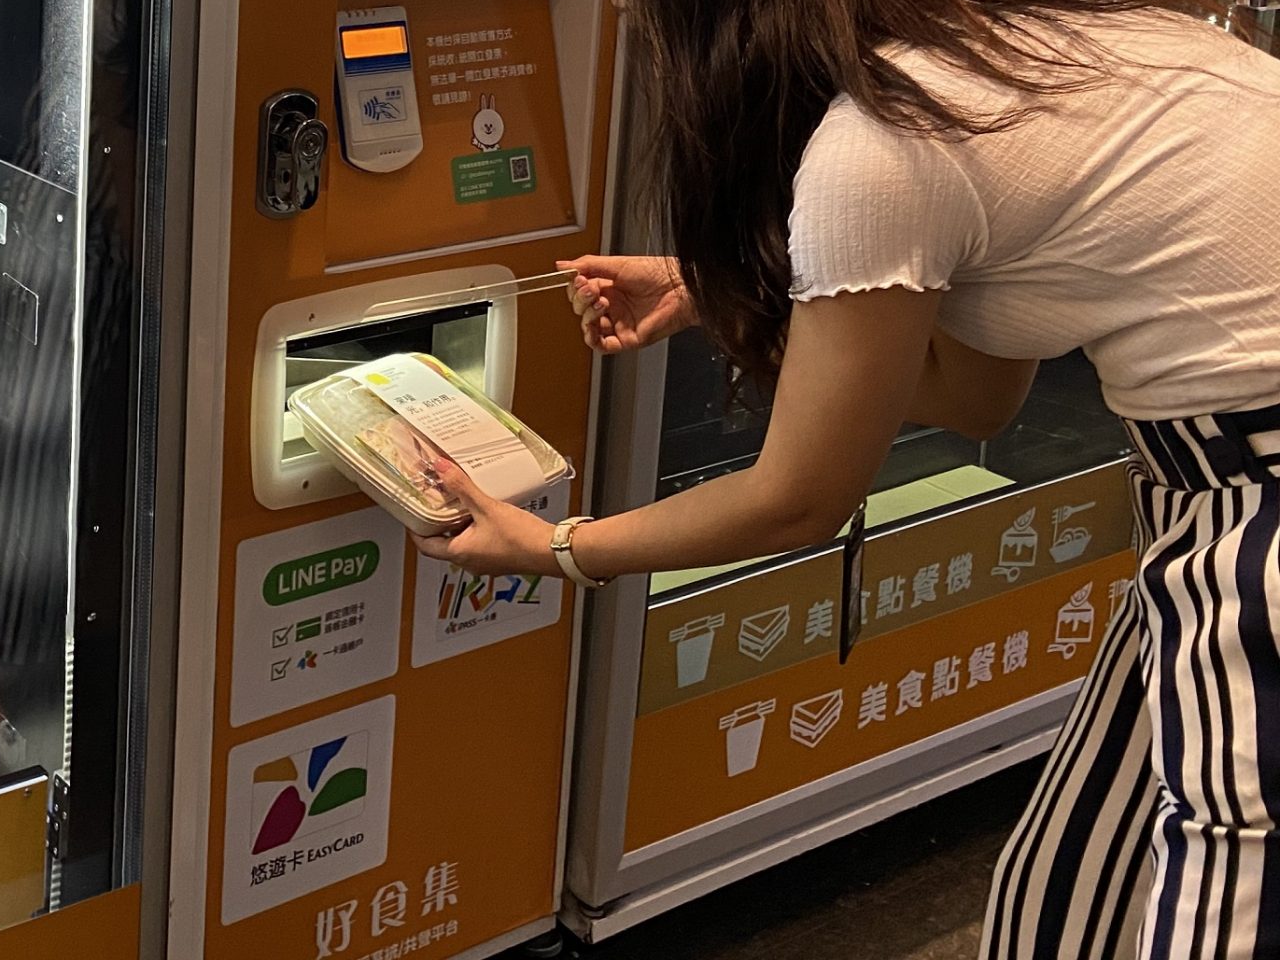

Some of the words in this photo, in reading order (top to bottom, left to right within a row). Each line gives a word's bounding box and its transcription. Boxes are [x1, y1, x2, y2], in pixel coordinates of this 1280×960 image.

[278, 561, 326, 595] LINE
[330, 553, 367, 579] Pay
[804, 551, 974, 645] 美點餐機
[856, 630, 1030, 731] 美食點餐機
[250, 850, 304, 887] 悠遊卡
[316, 861, 460, 960] 好食集
